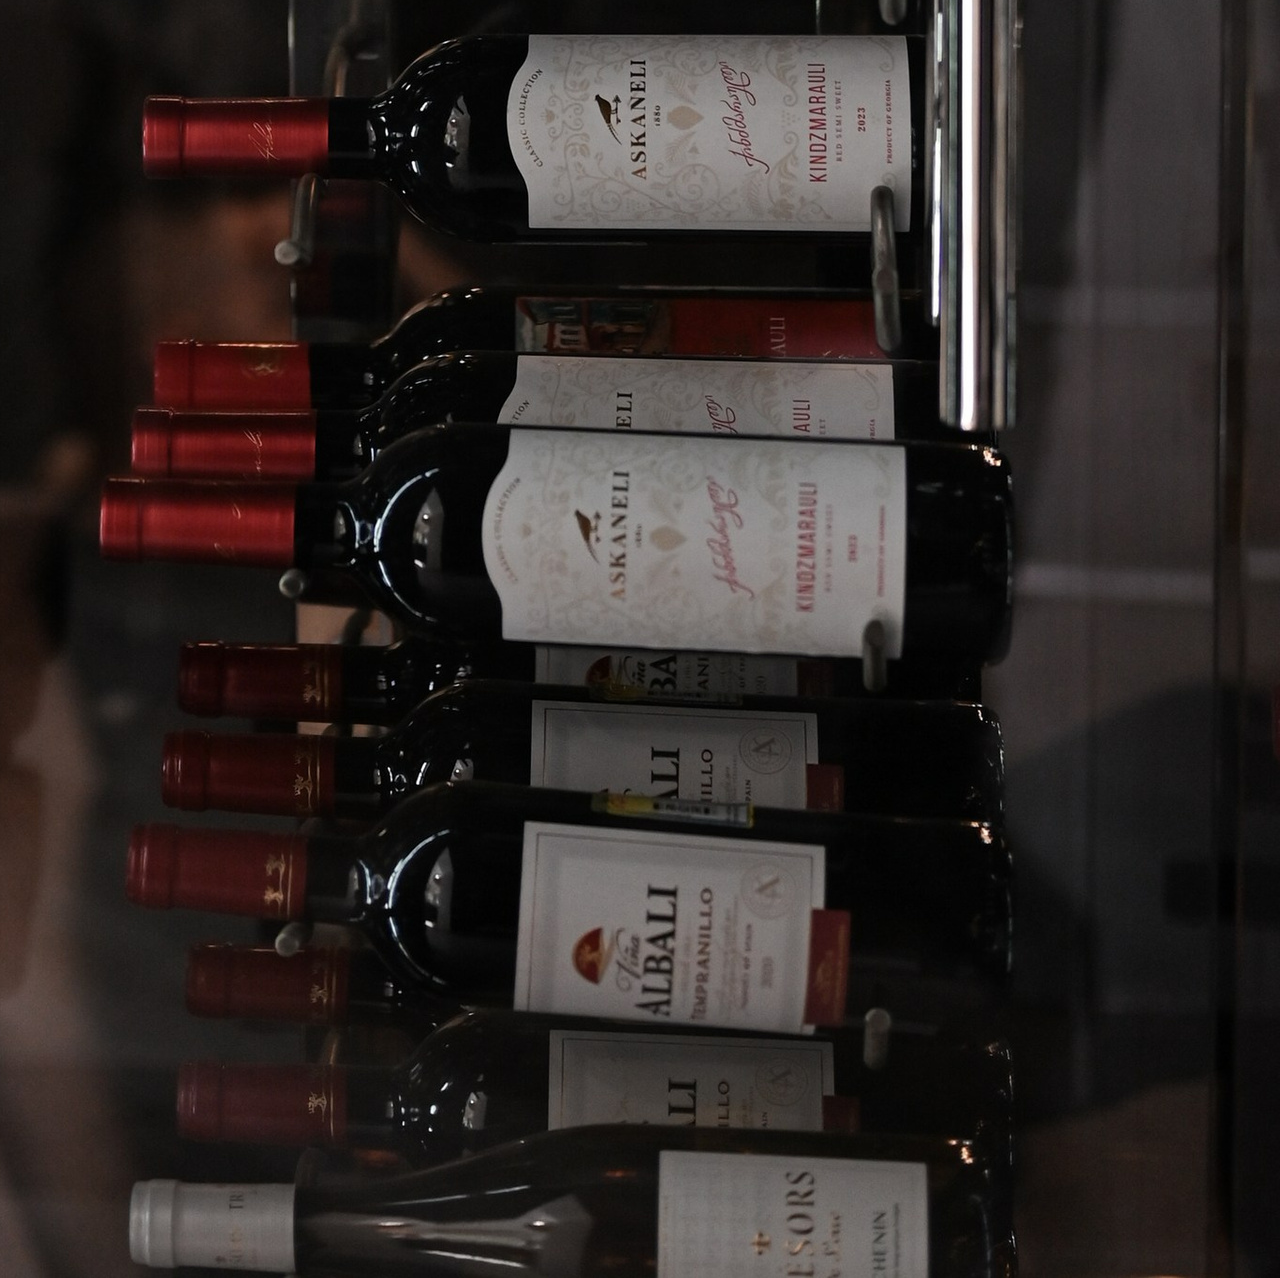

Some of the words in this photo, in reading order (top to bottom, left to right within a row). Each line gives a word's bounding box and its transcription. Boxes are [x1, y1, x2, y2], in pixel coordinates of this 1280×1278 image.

[517, 67, 545, 126] COLLECTION
[833, 78, 842, 110] SWEET
[884, 78, 892, 113] GEORGIA
[629, 58, 647, 181] ASKANELI
[807, 62, 828, 183] KINDZMARAULI
[834, 113, 843, 139] SEMI
[856, 106, 867, 133] 2023
[885, 114, 893, 126] OF
[520, 128, 545, 168] CLASSIC
[834, 142, 843, 162] RED
[885, 128, 893, 165] PRODUCT
[610, 470, 631, 603] ASKANELI
[795, 481, 818, 613] KINDZMARAULI
[615, 928, 642, 993] Viña
[635, 883, 678, 1017] ALBALI
[689, 886, 714, 1021] TEMPRANILLO
